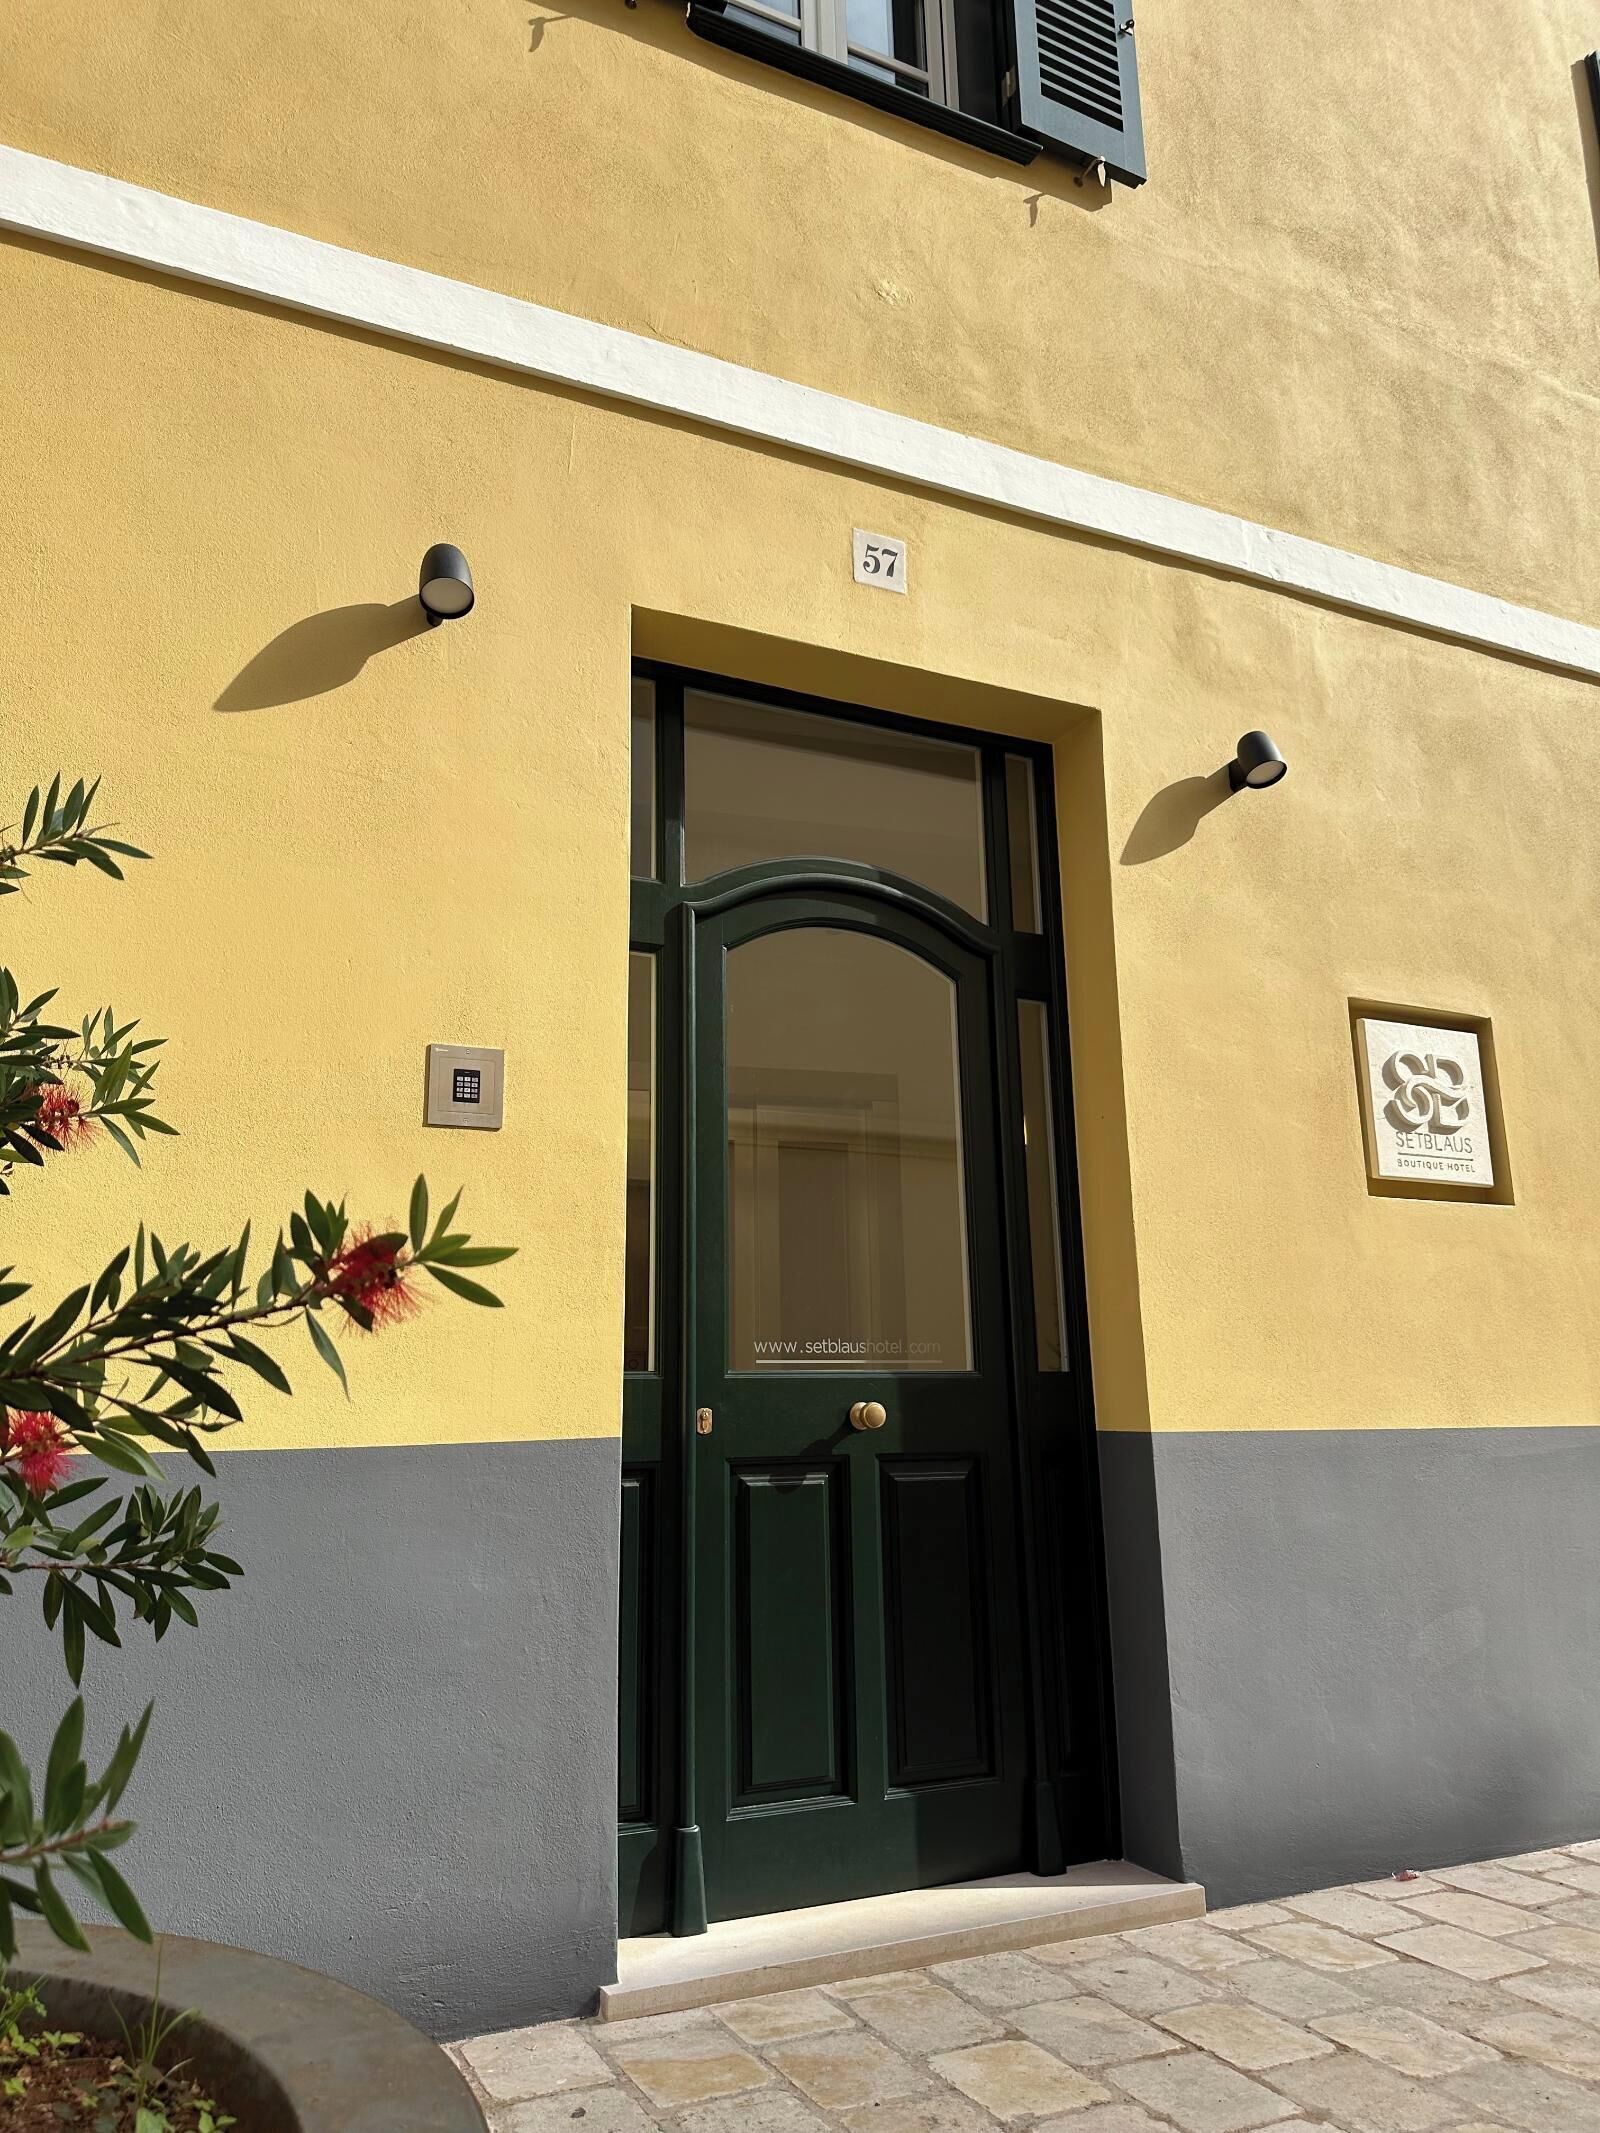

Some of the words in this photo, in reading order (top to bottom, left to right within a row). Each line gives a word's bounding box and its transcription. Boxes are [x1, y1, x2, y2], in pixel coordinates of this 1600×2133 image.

[863, 544, 898, 577] 57
[1396, 1131, 1473, 1153] SETBLAUS
[1397, 1159, 1444, 1170] BOUTIQUE
[1447, 1162, 1476, 1173] HOTEL
